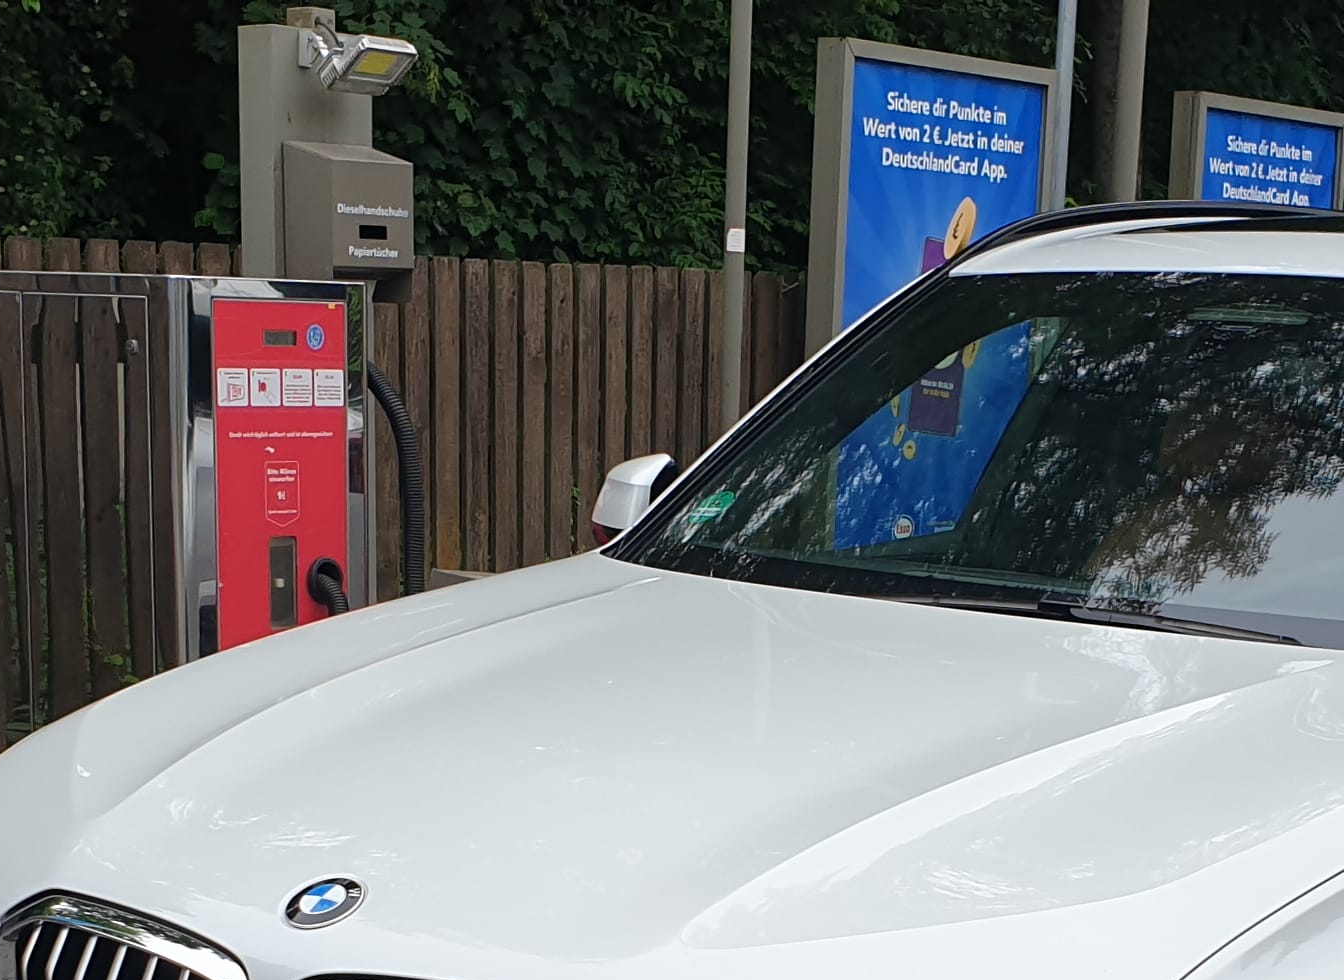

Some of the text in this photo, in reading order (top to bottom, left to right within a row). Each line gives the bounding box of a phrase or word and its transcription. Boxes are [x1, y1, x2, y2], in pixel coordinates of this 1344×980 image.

[887, 91, 1007, 127] Sichere dir Punkte im
[862, 117, 896, 139] Wert
[899, 126, 920, 143] von
[922, 124, 930, 143] 2
[944, 128, 974, 149] Jetzt
[977, 130, 988, 150] in
[990, 133, 1024, 155] deiner
[1227, 135, 1312, 161] Sichere dir Punkte im
[882, 147, 1007, 184] DeutschlandCard App.
[1209, 157, 1233, 176] Wert
[1235, 163, 1250, 178] von
[1251, 162, 1257, 178] 2
[1266, 165, 1287, 183] Jetzt
[1288, 166, 1297, 183] in
[1299, 168, 1323, 186] deiner
[1222, 182, 1290, 205] DeutschlandCard
[337, 203, 409, 218] Dieselhandschuhe
[348, 245, 399, 259] Papiertücher
